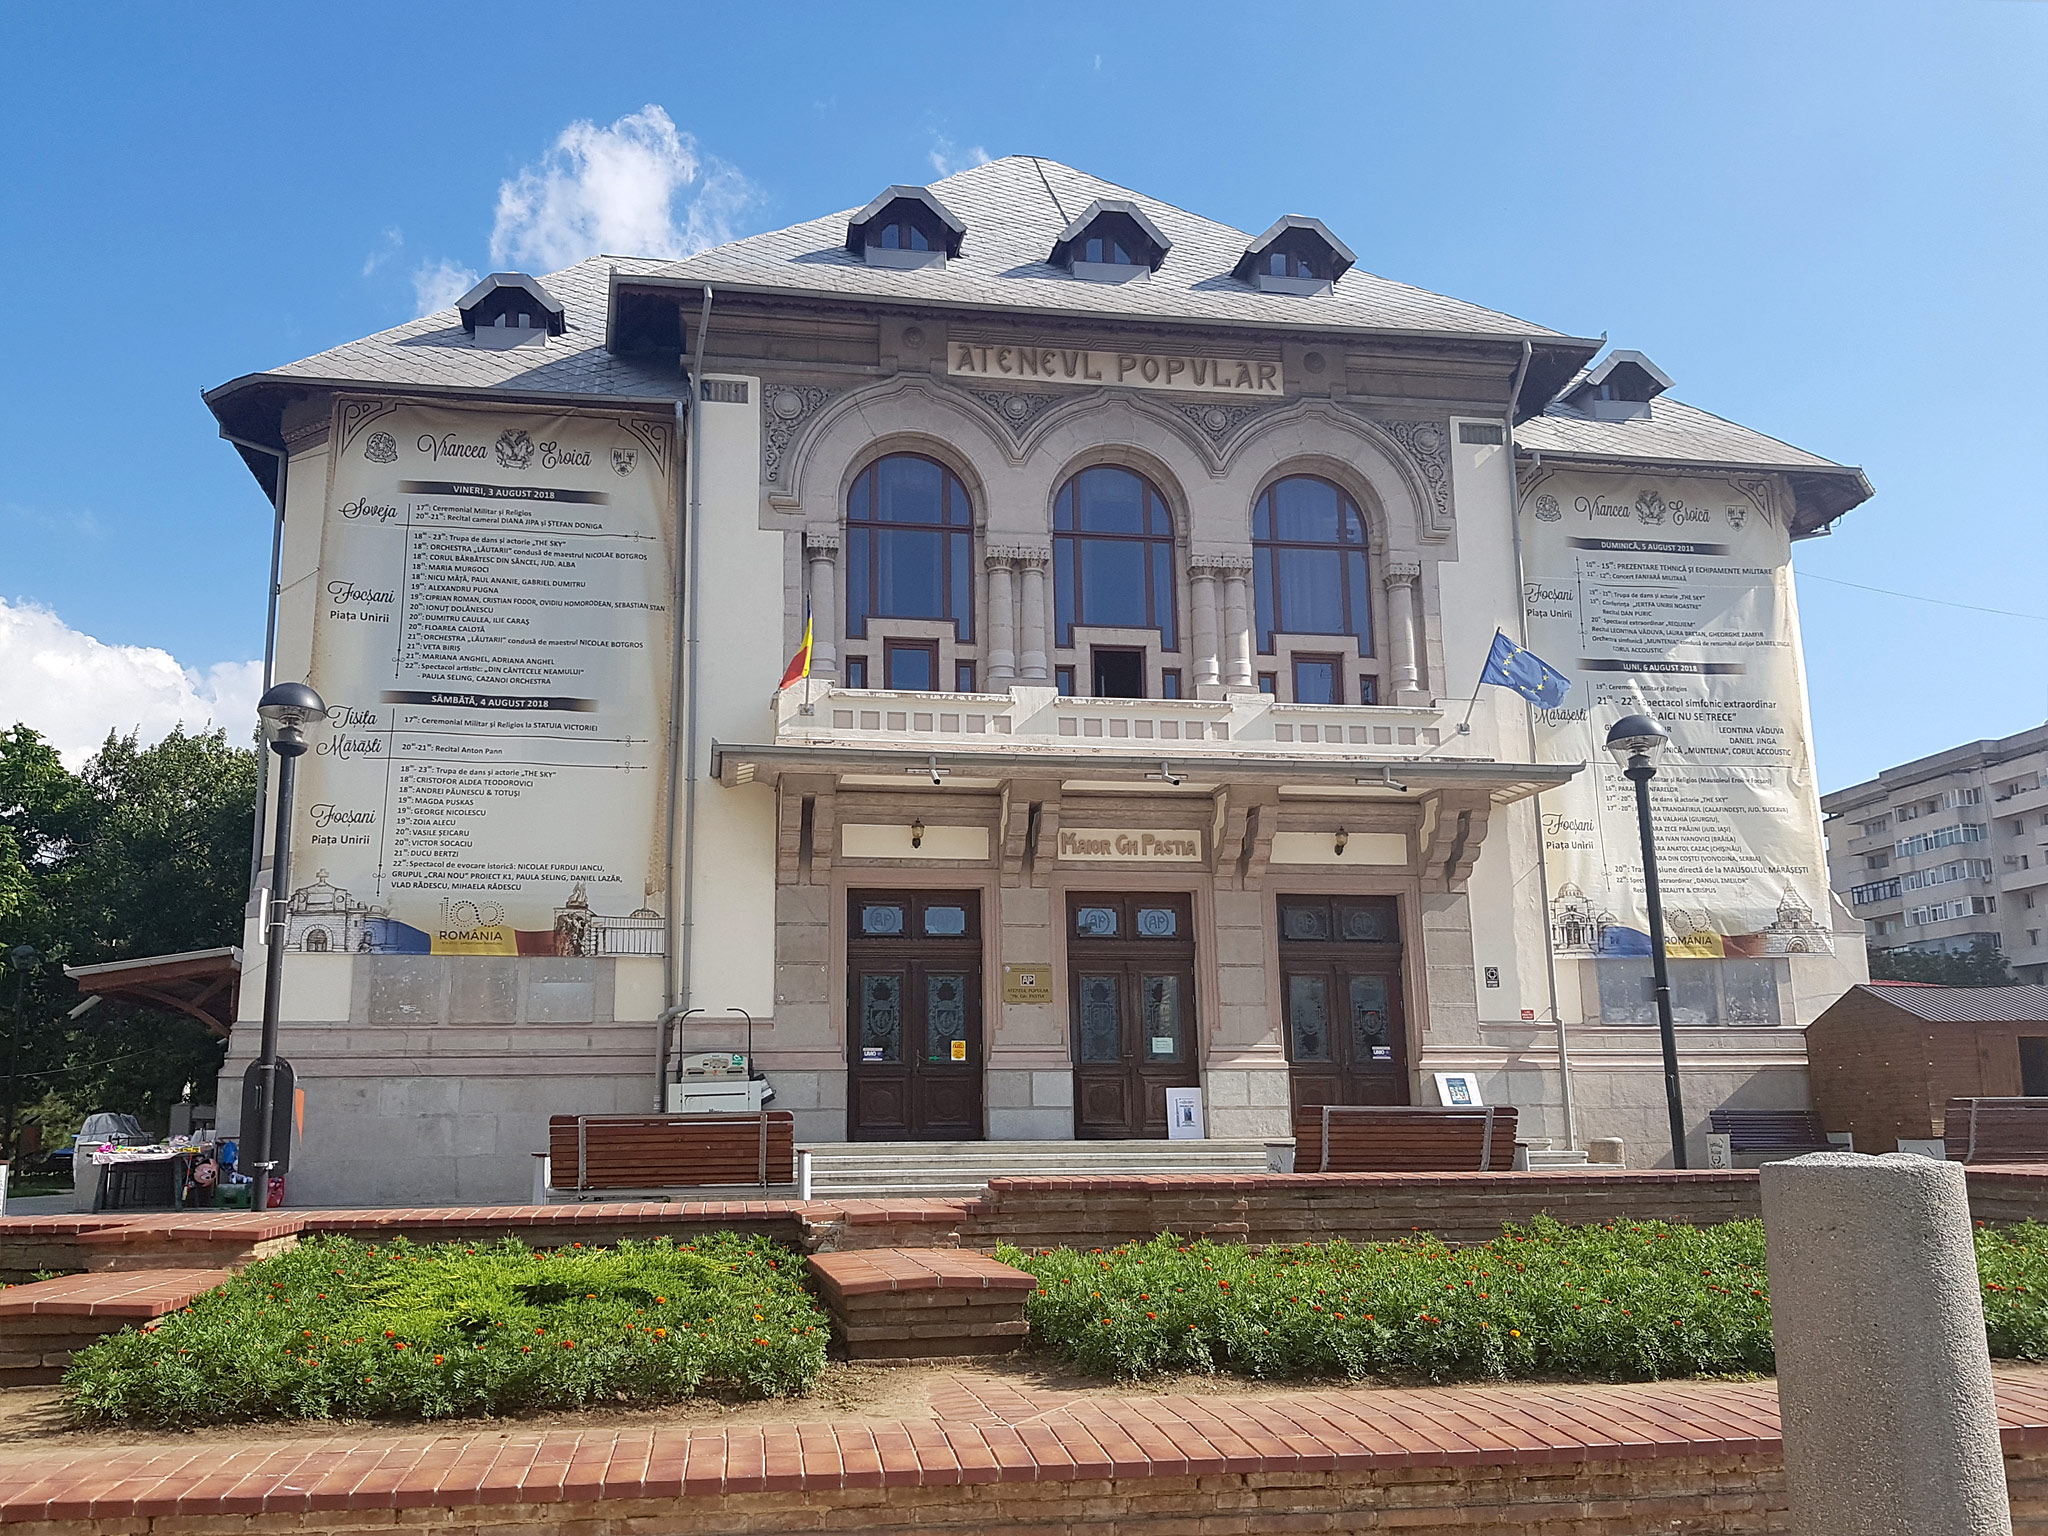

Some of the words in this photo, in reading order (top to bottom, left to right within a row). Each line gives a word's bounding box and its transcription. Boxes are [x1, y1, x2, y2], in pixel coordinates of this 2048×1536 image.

[417, 434, 488, 462] Vrancea
[488, 488, 494, 496] 3
[496, 489, 532, 498] AUGUST
[534, 491, 556, 499] 2018
[338, 497, 398, 522] Soveja
[1574, 495, 1631, 520] Vrancea
[360, 612, 389, 622] Unirii
[1550, 610, 1572, 619] Unirii
[488, 699, 525, 707] AUGUST
[527, 700, 549, 708] 2018
[340, 835, 370, 844] Unirii
[1572, 841, 1594, 849] Unirii
